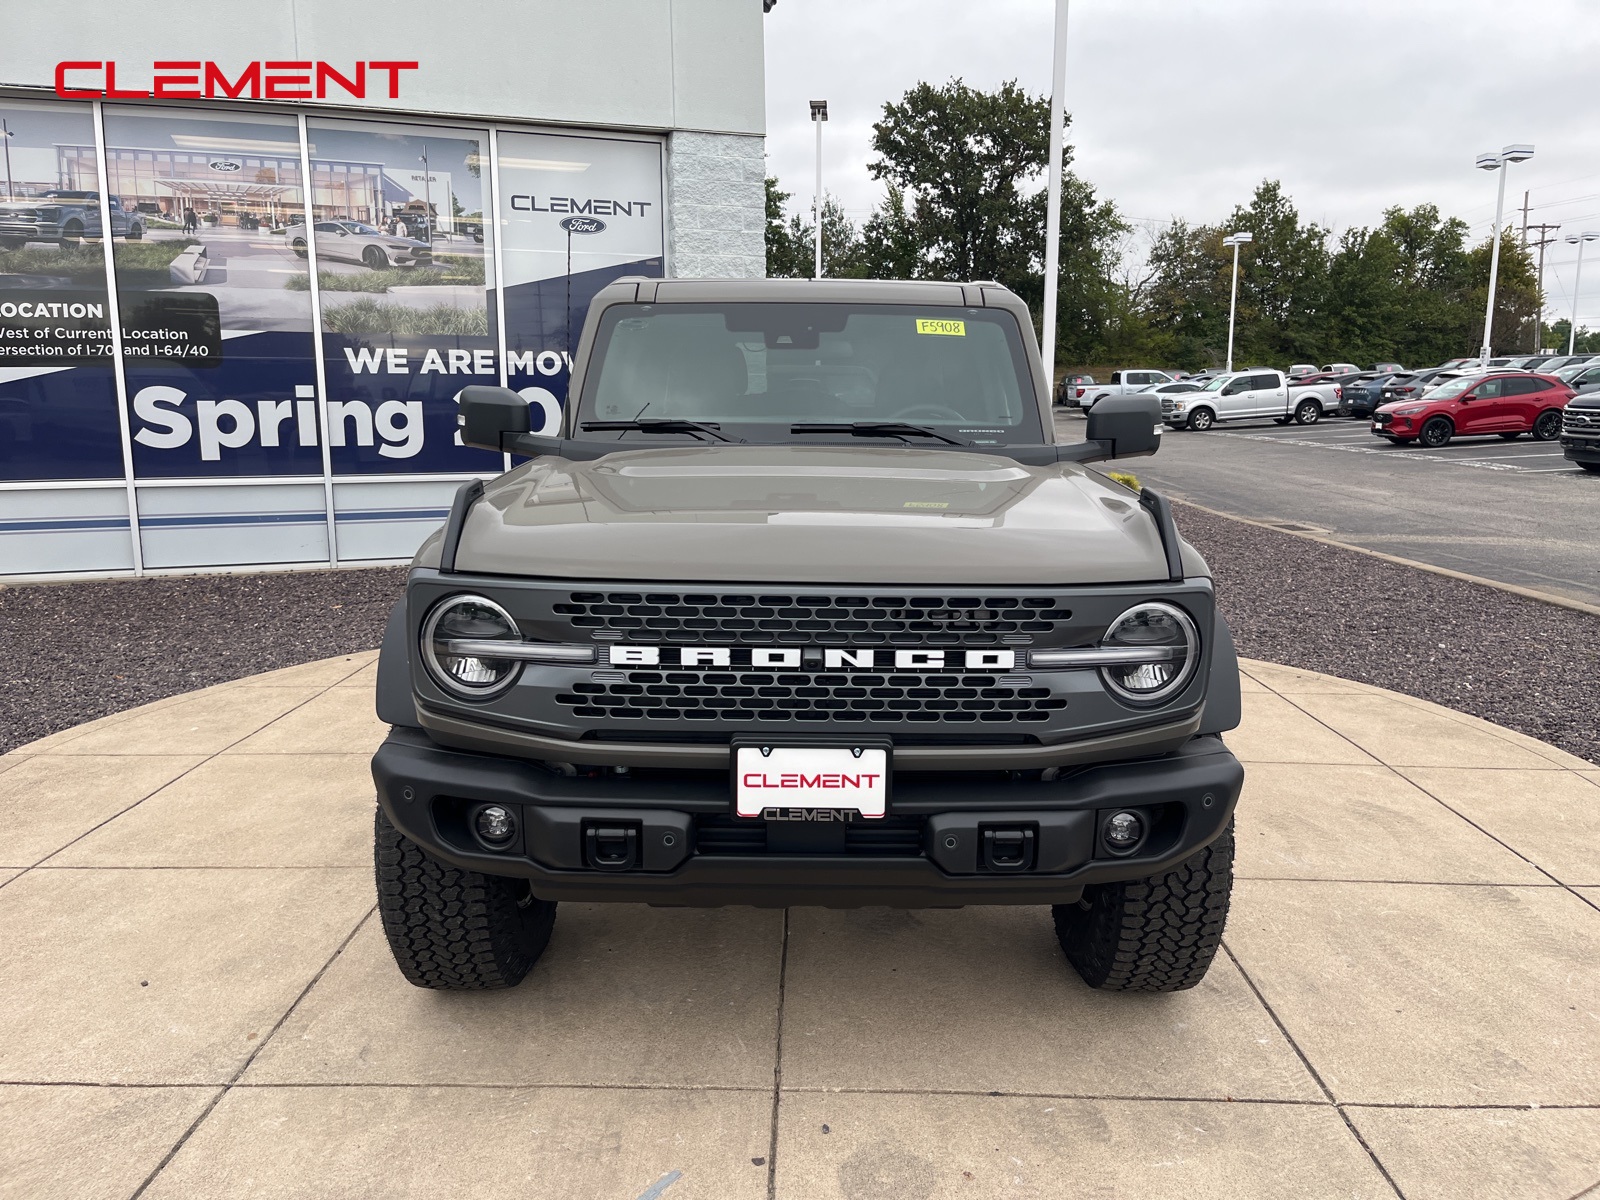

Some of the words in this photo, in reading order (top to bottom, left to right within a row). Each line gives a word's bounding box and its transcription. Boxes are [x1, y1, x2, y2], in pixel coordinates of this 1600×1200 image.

[411, 174, 437, 182] RETAER
[511, 195, 651, 217] CLEMENT
[569, 219, 597, 231] Ford
[0, 302, 104, 318] OCATION
[34, 327, 50, 339] of
[55, 327, 113, 339] Current
[122, 327, 189, 340] Location
[921, 321, 960, 333] F5908
[67, 344, 82, 356] of
[86, 344, 114, 356] I-70
[124, 344, 150, 356] and
[154, 344, 209, 358] I-64/40
[343, 347, 409, 374] WE
[420, 349, 495, 375] ARE
[134, 385, 425, 460] Spring
[609, 645, 1016, 669] BRONCO
[743, 773, 881, 789] CLEMENT
[763, 808, 858, 822] CLEMENT
